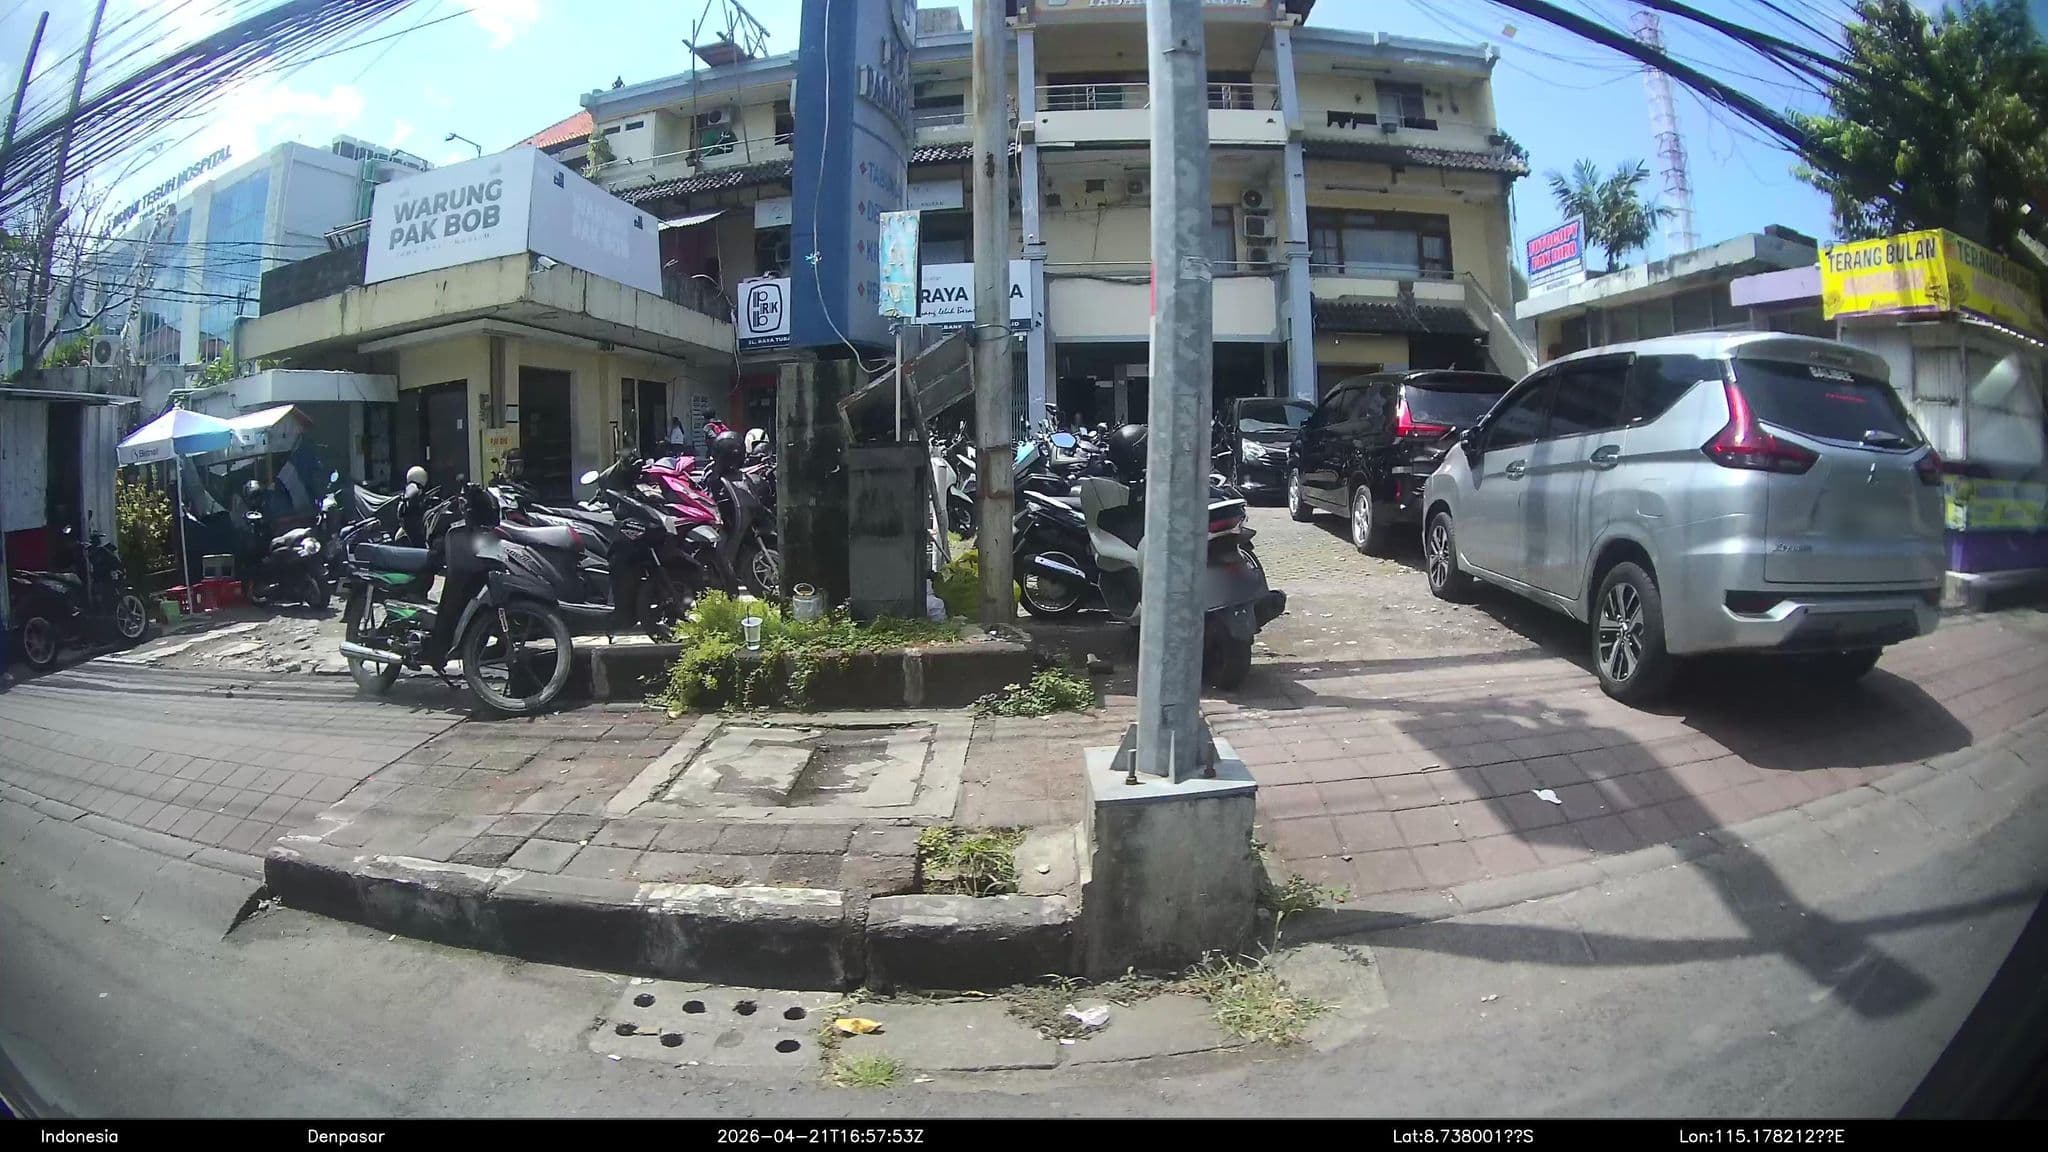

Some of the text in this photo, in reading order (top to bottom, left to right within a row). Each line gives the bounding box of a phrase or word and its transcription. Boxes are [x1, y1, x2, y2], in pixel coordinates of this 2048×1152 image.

[142, 177, 175, 210] TEGUH
[176, 144, 232, 190] HOSPITAL
[394, 178, 503, 224] WARUNG
[388, 217, 438, 250] PAK
[443, 204, 501, 237] BOB
[1828, 237, 1937, 273] TERANG BULAN
[921, 286, 968, 304] RAYA
